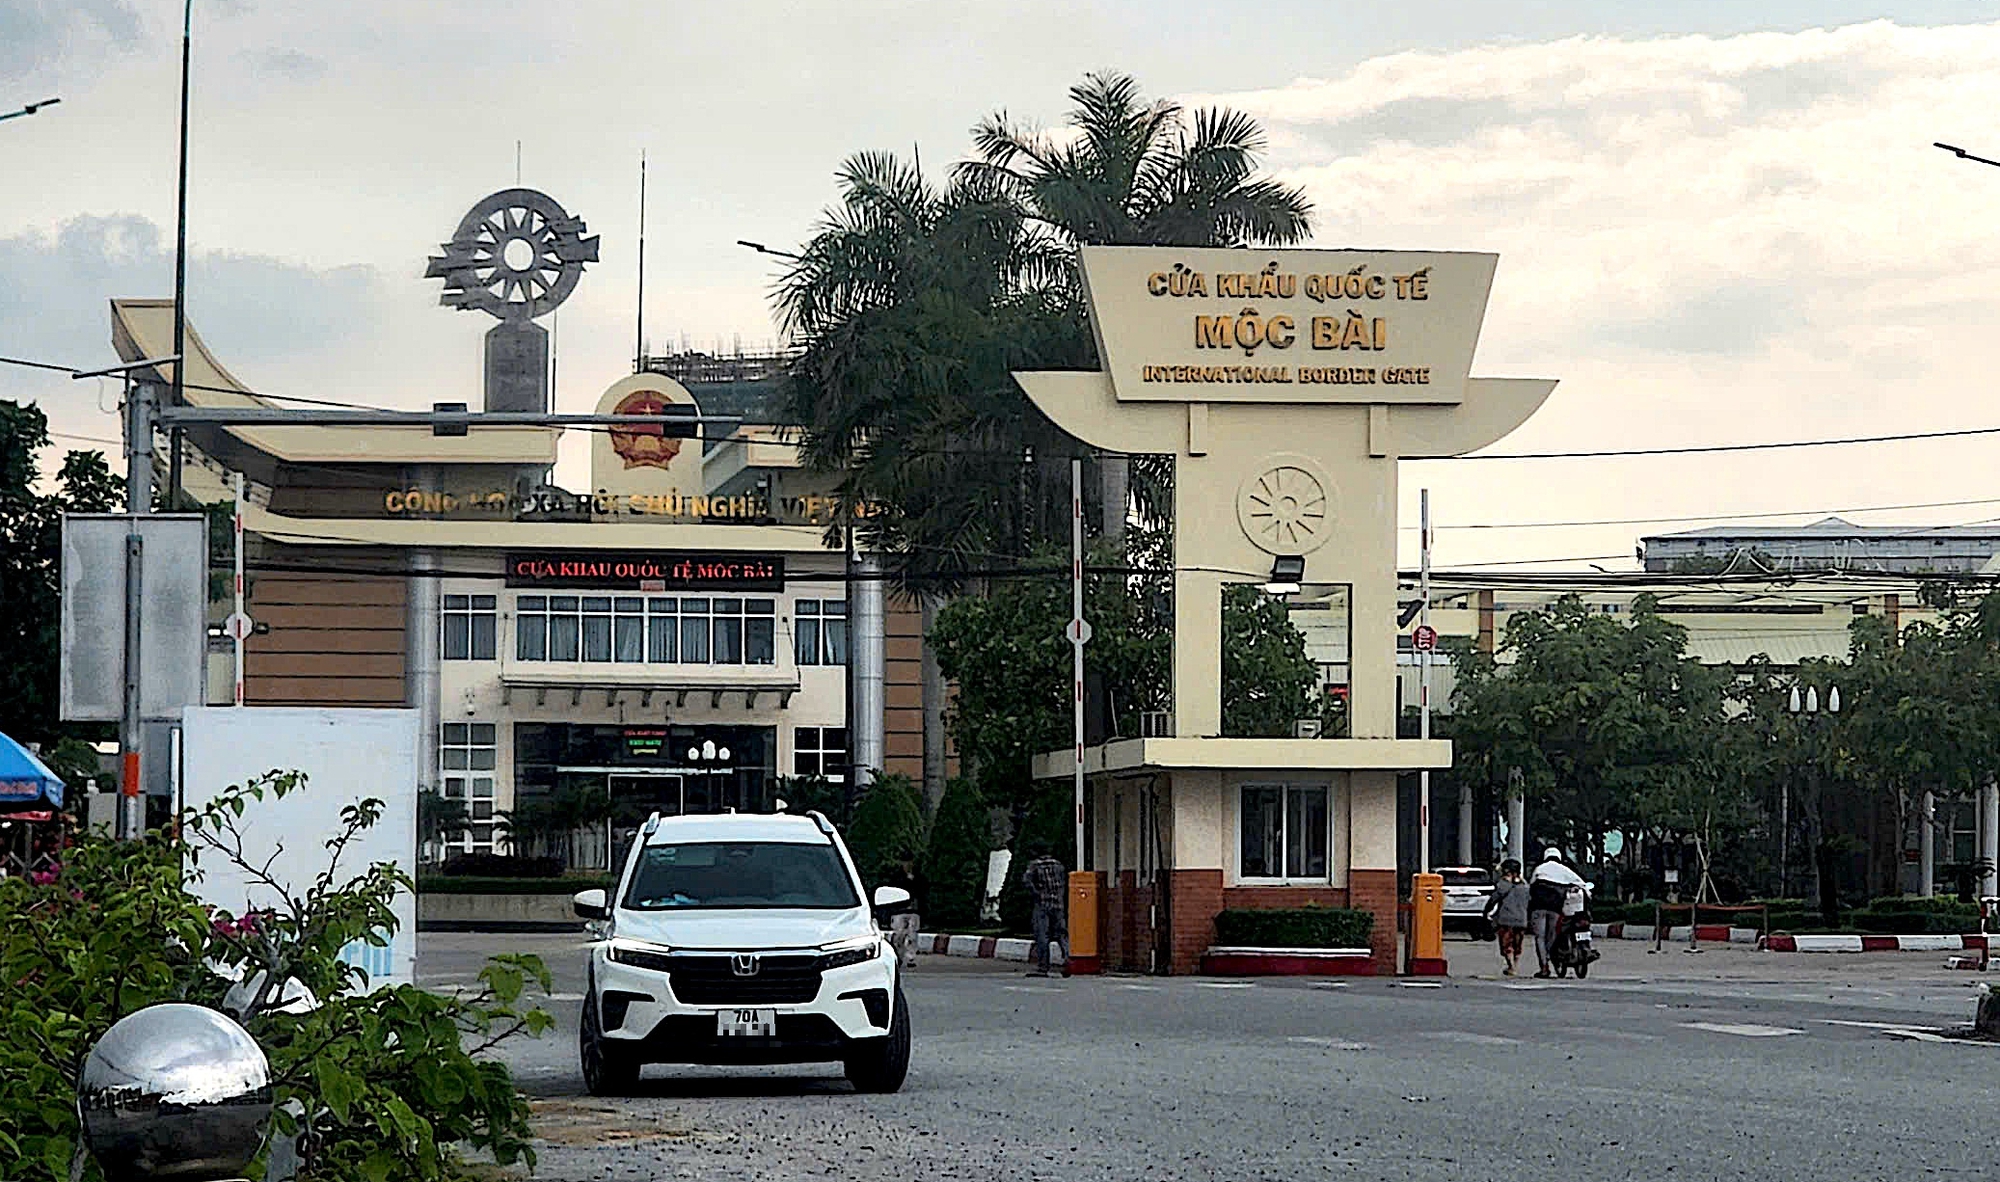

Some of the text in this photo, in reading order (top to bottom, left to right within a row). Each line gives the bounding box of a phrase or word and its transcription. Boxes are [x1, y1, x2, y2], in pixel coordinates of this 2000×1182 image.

[1148, 261, 1433, 303] CỬA KHẨU QUỐC TẾ
[1196, 307, 1386, 357] MỘC BÀI
[1143, 365, 1430, 385] INTERNATIONAL BORDER GATE
[734, 1010, 759, 1023] 70A
